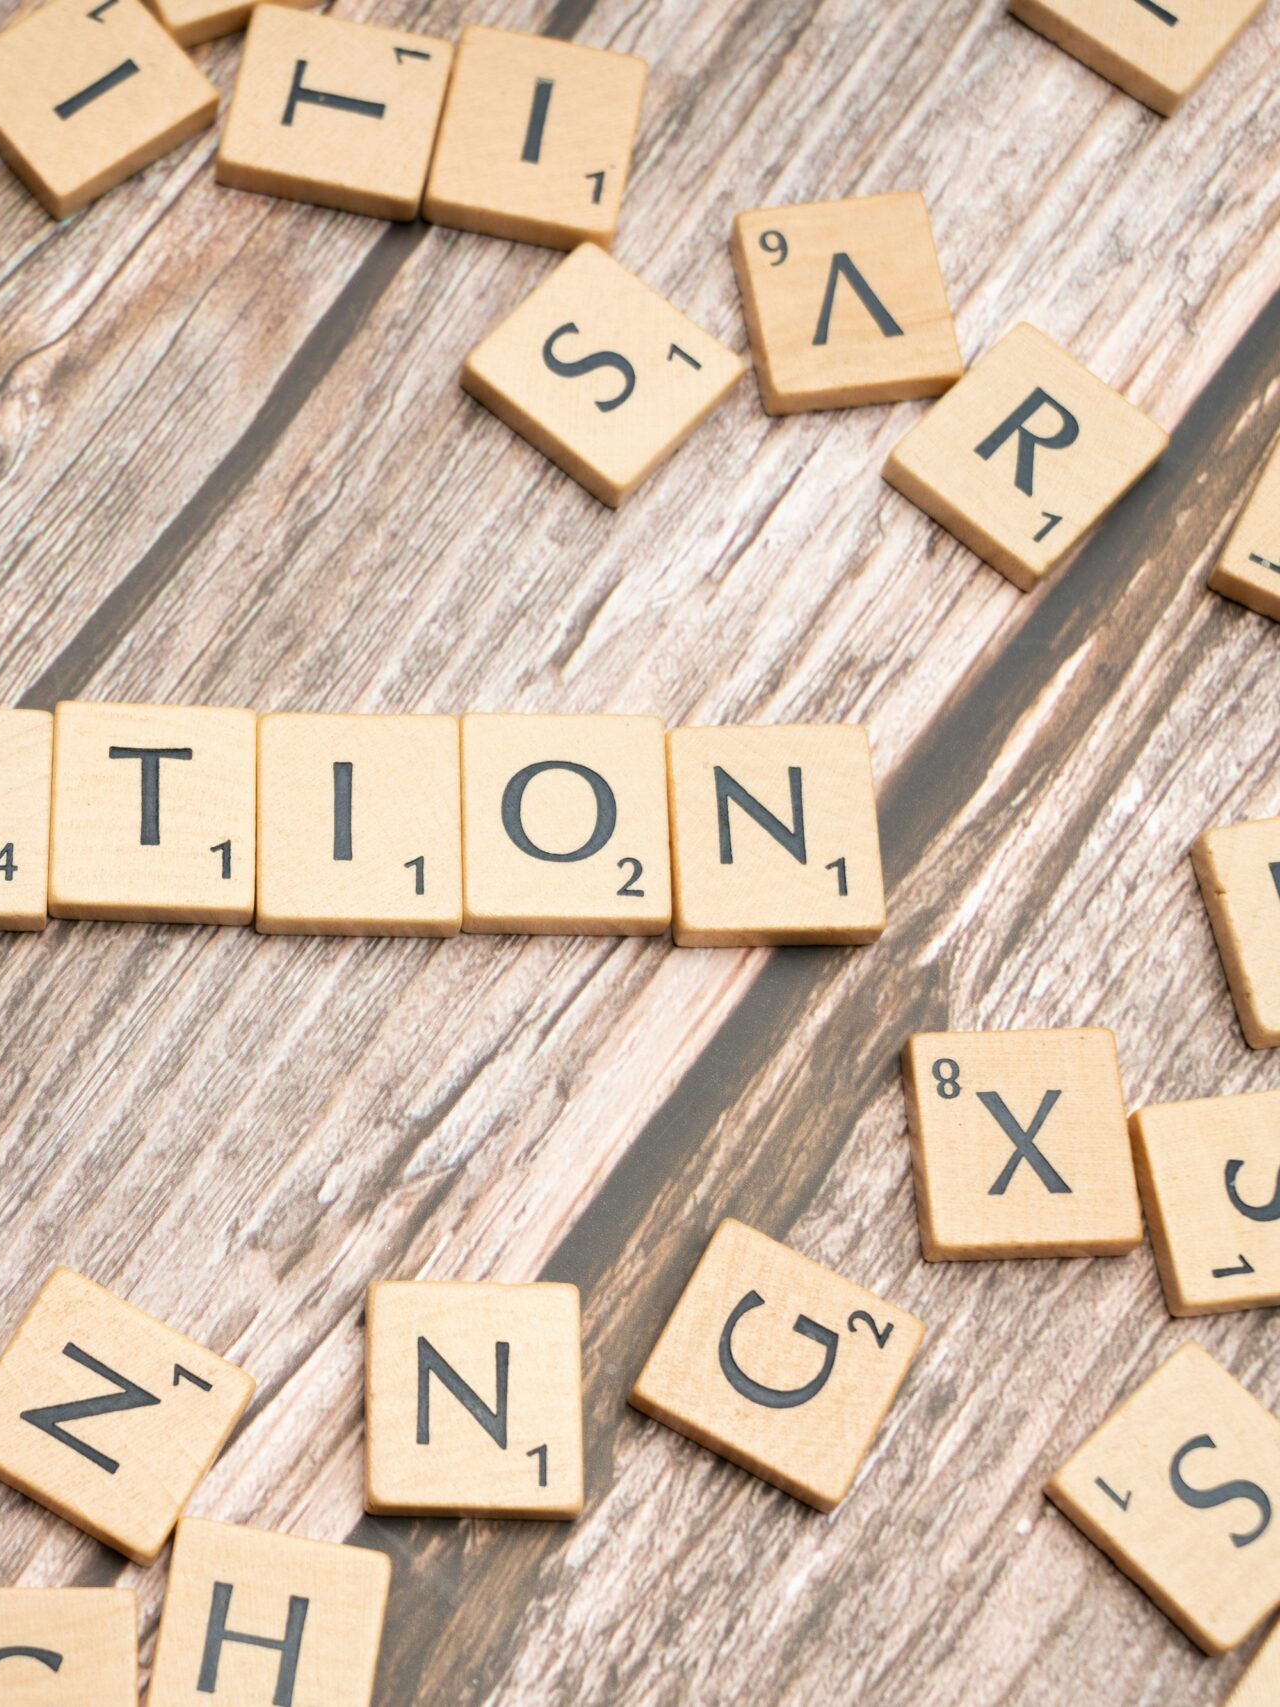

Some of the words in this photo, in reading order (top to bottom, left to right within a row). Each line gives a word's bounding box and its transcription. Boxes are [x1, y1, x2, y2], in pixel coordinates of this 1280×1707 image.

[53, 59, 140, 120] I
[281, 59, 386, 126] T
[394, 47, 431, 63] 1
[521, 78, 554, 164] I
[586, 171, 605, 204] 1
[542, 322, 636, 412] S
[667, 344, 702, 370] 1
[974, 387, 1079, 497] R
[1033, 512, 1063, 543] 1
[210, 840, 231, 879] 1
[404, 856, 424, 895] 1
[617, 857, 644, 897] 2
[825, 857, 848, 896] 1
[932, 1058, 962, 1099] 8
[976, 1090, 1072, 1195] X
[1212, 1254, 1255, 1278] 1
[173, 1364, 213, 1392] 1
[718, 1290, 839, 1409] G
[847, 1310, 894, 1349] 2
[416, 1336, 509, 1450] N
[526, 1444, 547, 1487] 1
[1095, 1477, 1132, 1512] 1
[1169, 1434, 1272, 1548] S
[196, 1581, 309, 1707] H
